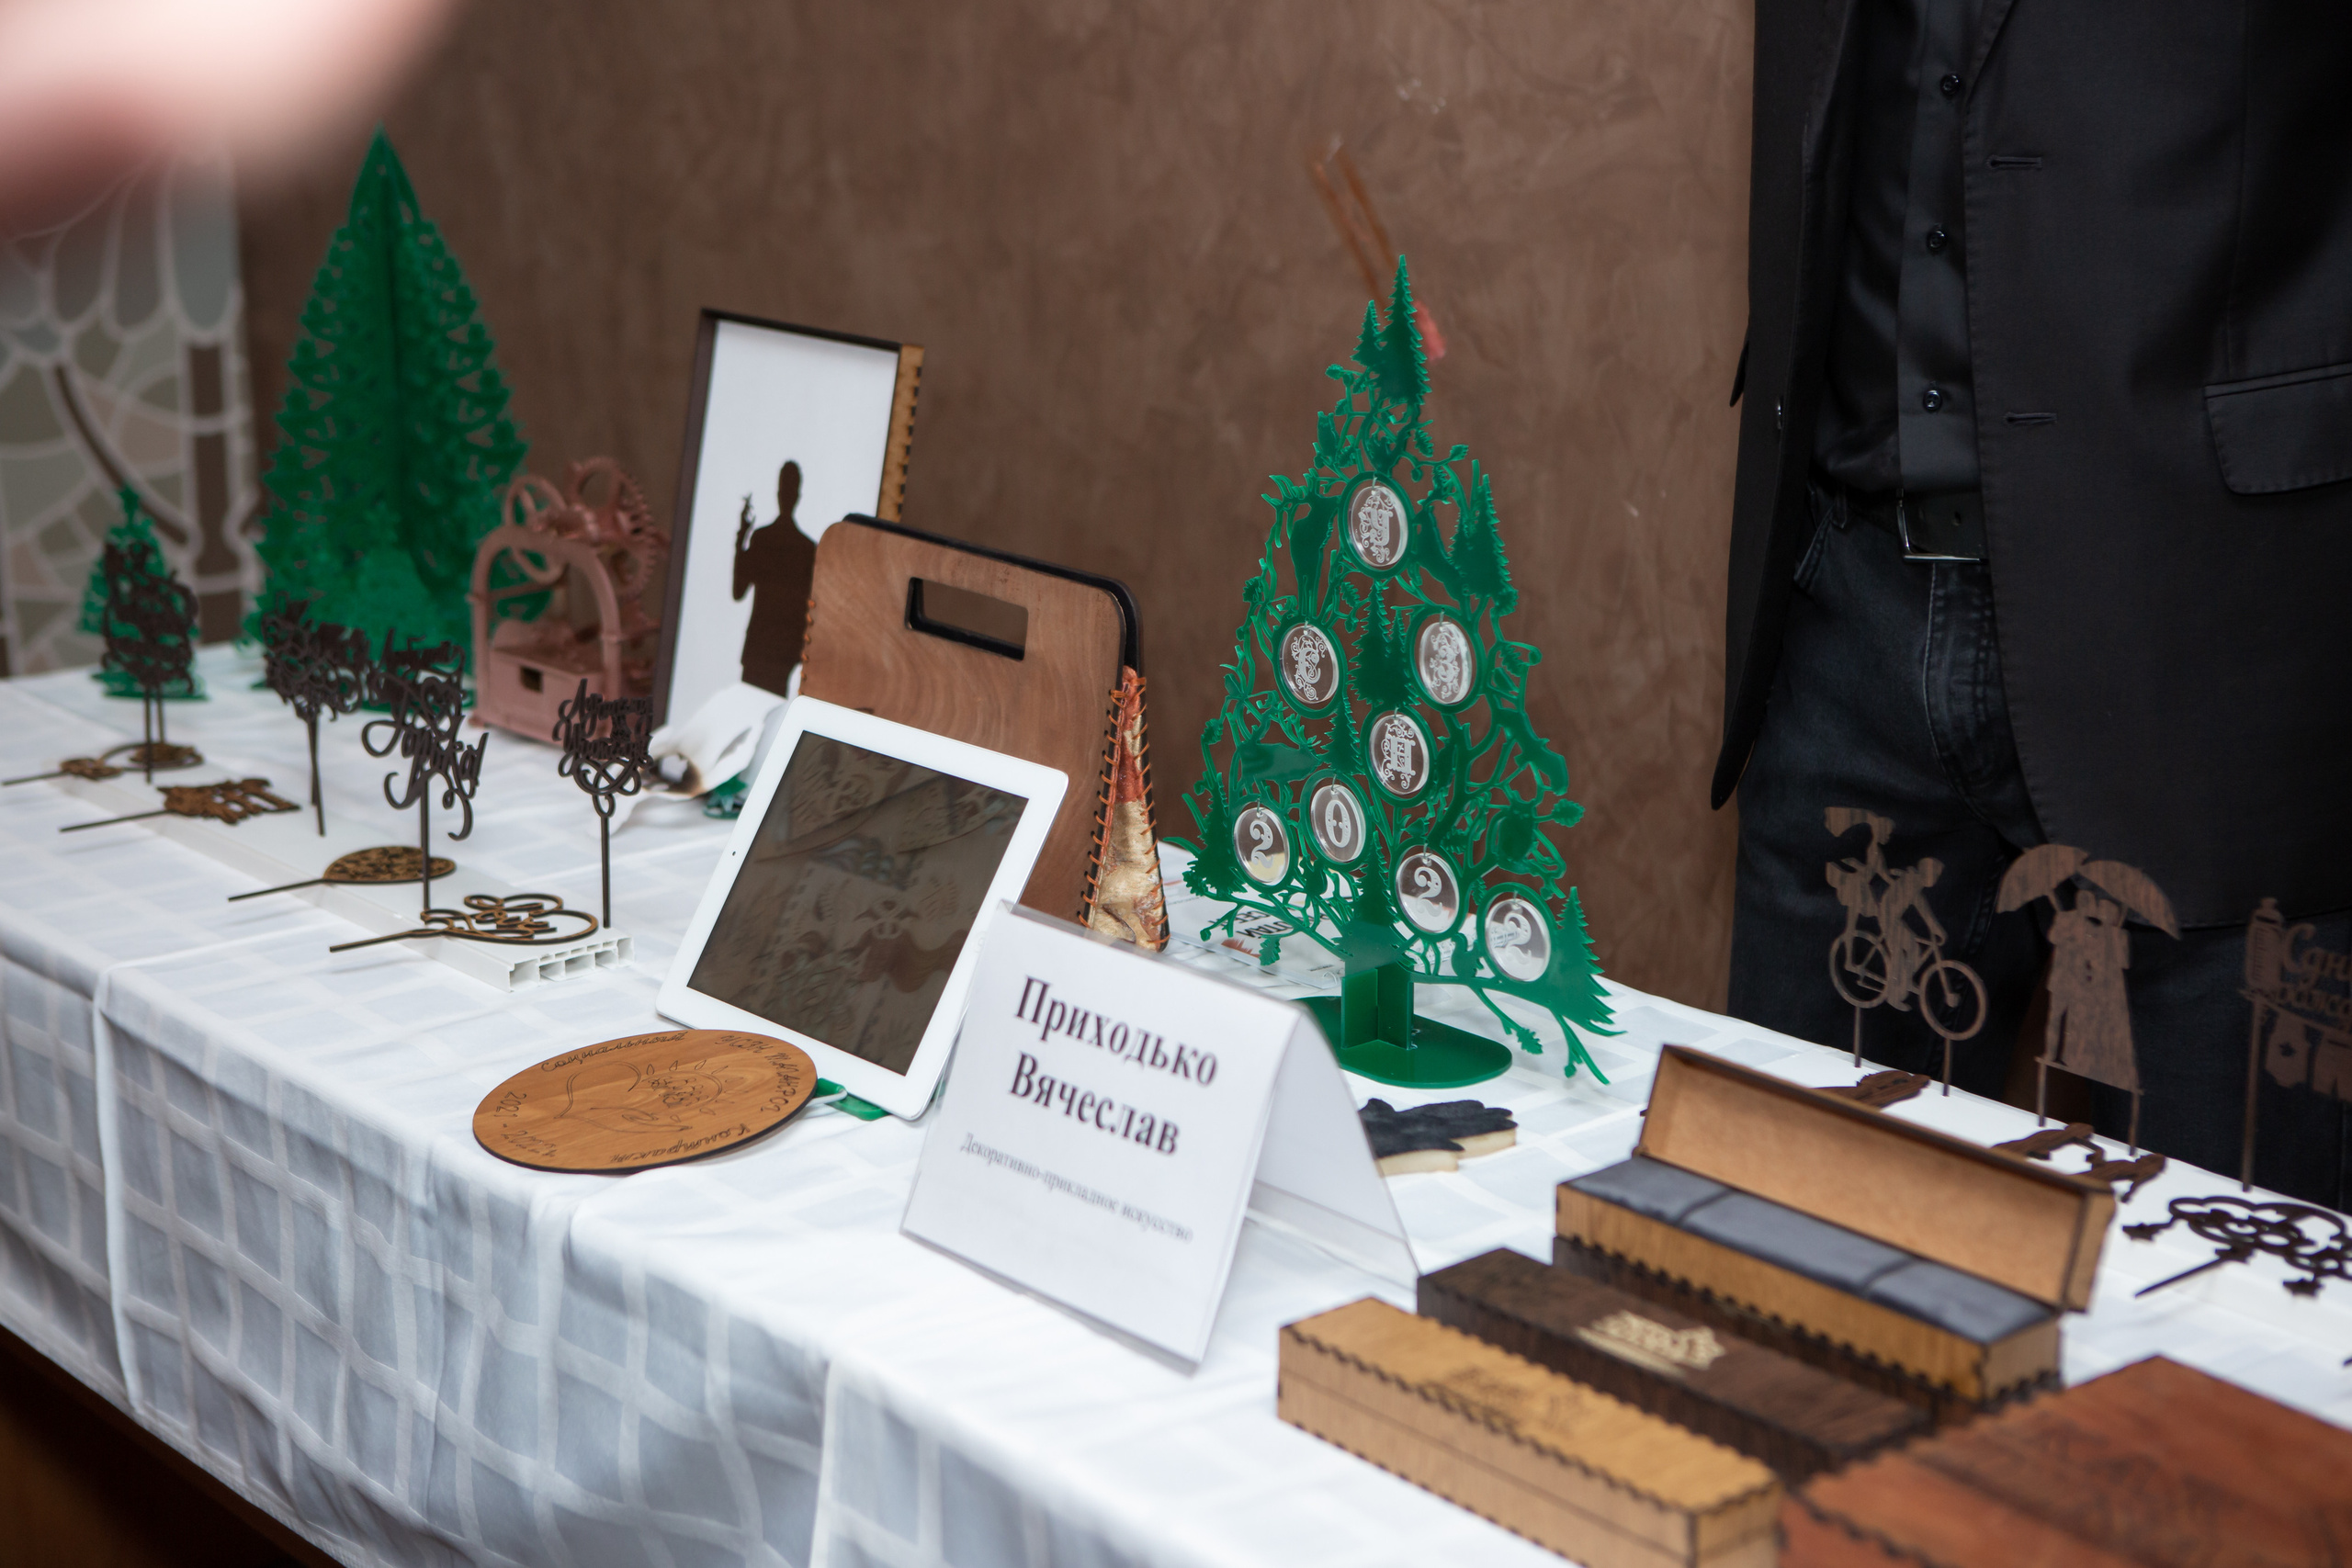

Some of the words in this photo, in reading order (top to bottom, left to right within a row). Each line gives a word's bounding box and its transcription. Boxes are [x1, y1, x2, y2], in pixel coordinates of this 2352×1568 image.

[1250, 820, 1273, 868] 2
[1325, 800, 1351, 848] 0
[1414, 866, 1442, 917] 2
[1504, 912, 1532, 964] 2
[541, 1031, 688, 1072] Социальный
[1014, 975, 1219, 1087] Приходько
[493, 1091, 527, 1118] 2021
[608, 1123, 751, 1164] Контракт
[1009, 1051, 1180, 1156] Вячеслав
[960, 1133, 1119, 1213] Декоративно-прикладное
[1122, 1201, 1193, 1244] искусство
